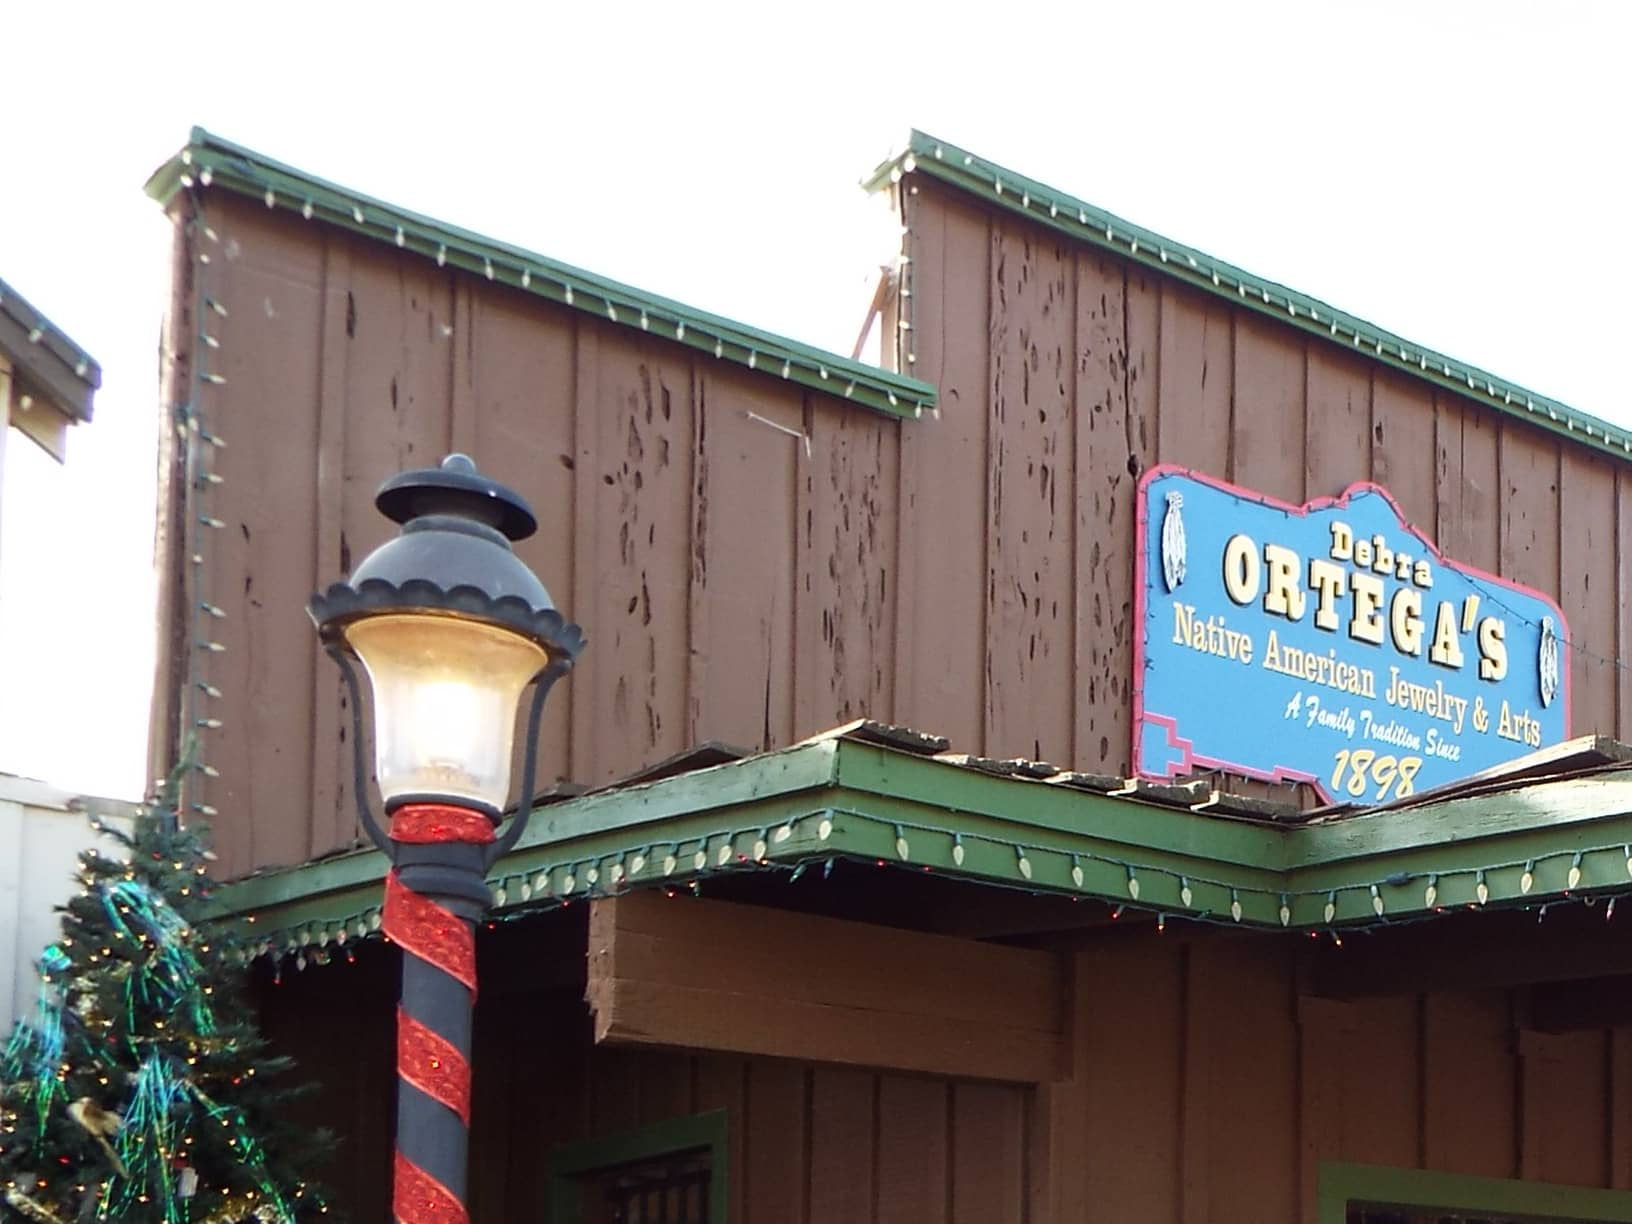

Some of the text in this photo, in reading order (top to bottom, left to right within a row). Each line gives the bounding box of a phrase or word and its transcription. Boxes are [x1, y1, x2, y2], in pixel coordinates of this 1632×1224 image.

[1330, 520, 1433, 588] Debra
[1223, 534, 1508, 681] ORTEGA'S
[1172, 601, 1542, 749] Native American Jewelry & Arts
[1284, 691, 1461, 763] A Family Tradition Since
[1331, 749, 1423, 801] 1898
